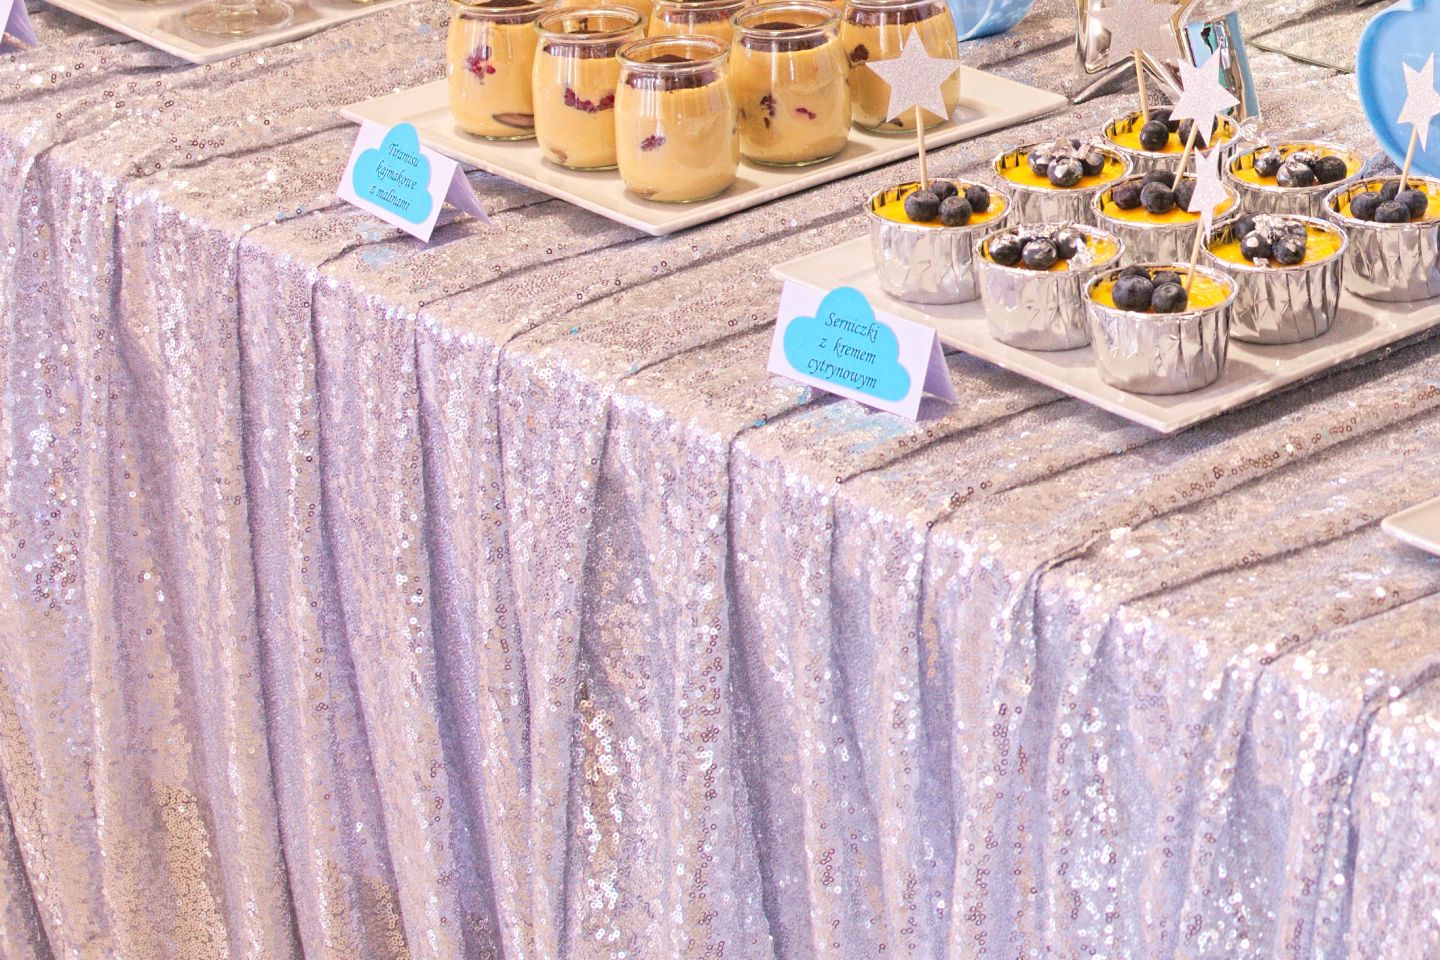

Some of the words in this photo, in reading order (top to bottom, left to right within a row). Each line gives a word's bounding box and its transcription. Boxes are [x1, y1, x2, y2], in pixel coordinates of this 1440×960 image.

[825, 311, 880, 344] Serniczki
[818, 337, 828, 349] z
[833, 337, 876, 365] kremem
[807, 357, 877, 390] cytrynowym
